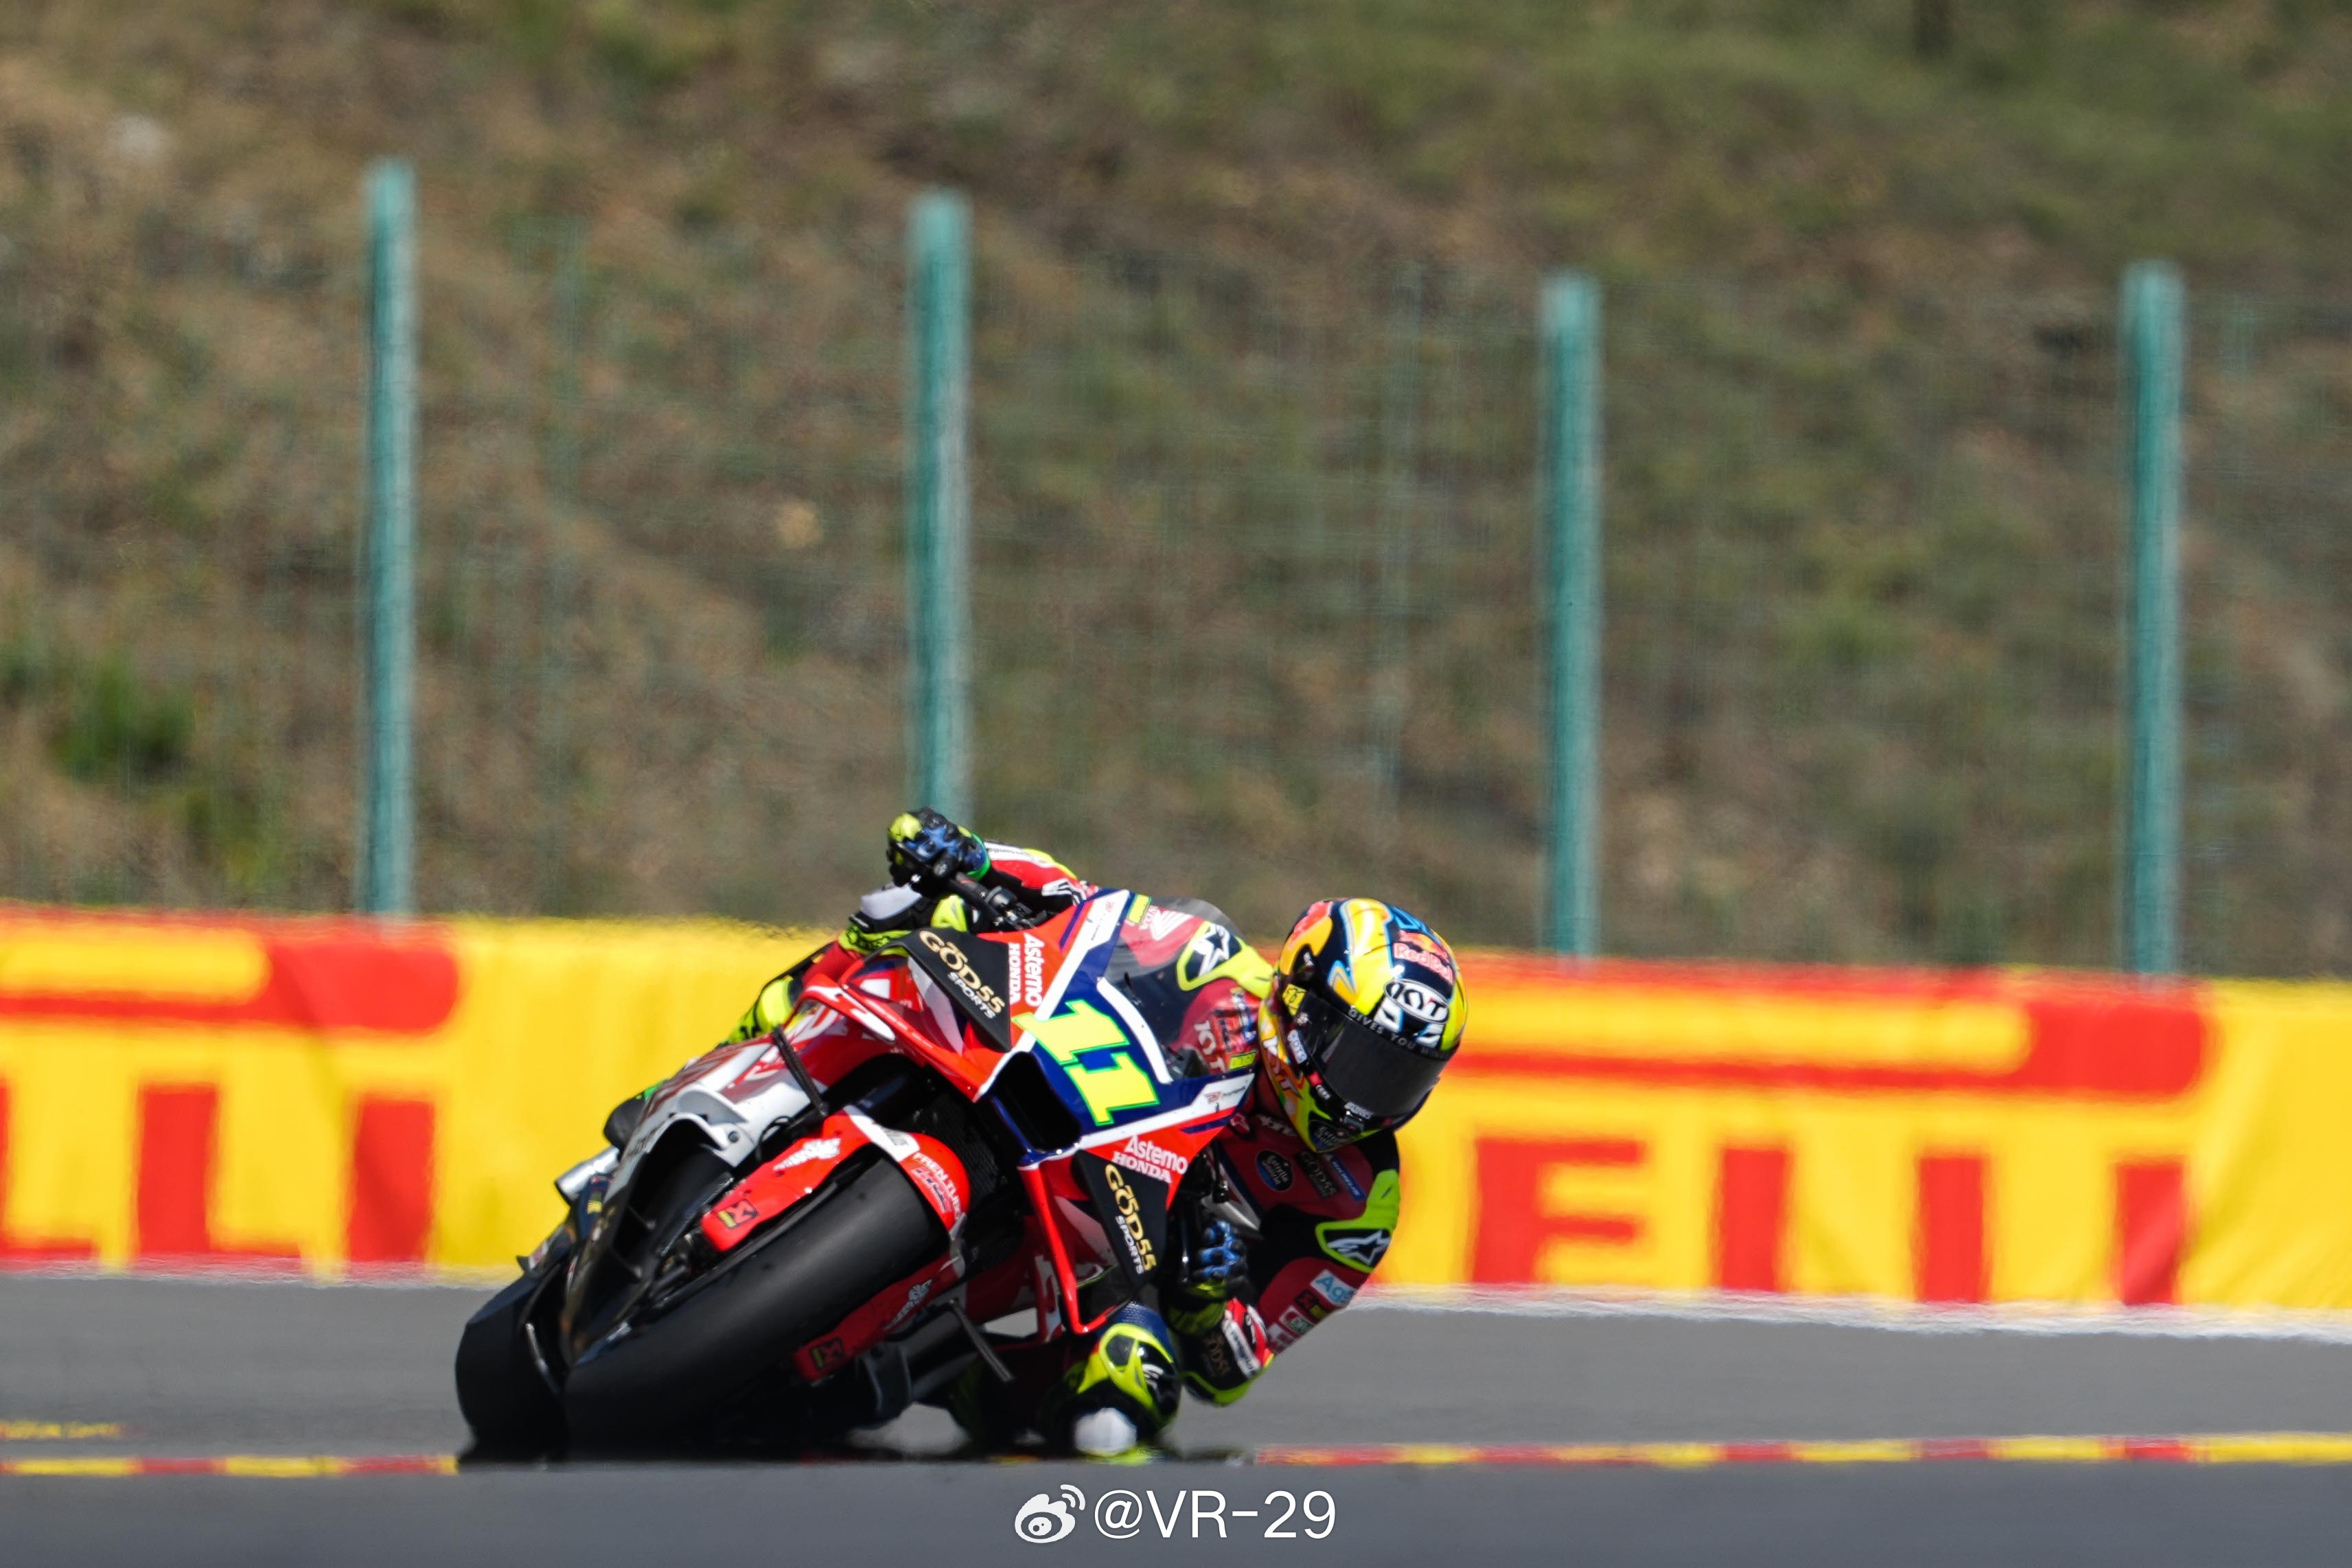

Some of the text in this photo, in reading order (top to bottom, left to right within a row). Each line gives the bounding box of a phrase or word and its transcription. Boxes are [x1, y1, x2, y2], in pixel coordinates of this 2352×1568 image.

[1008, 942, 1022, 1004] HONDA
[1024, 932, 1045, 1006] Astemo
[947, 971, 995, 1019] SPORTS
[1385, 981, 1449, 1020] KYT
[1348, 1008, 1416, 1050] GIVES YOU
[1011, 999, 1160, 1127] 11
[1111, 1151, 1173, 1184] HONDA
[1124, 1133, 1188, 1175] Astemo
[1115, 1215, 1143, 1275] SPORTS
